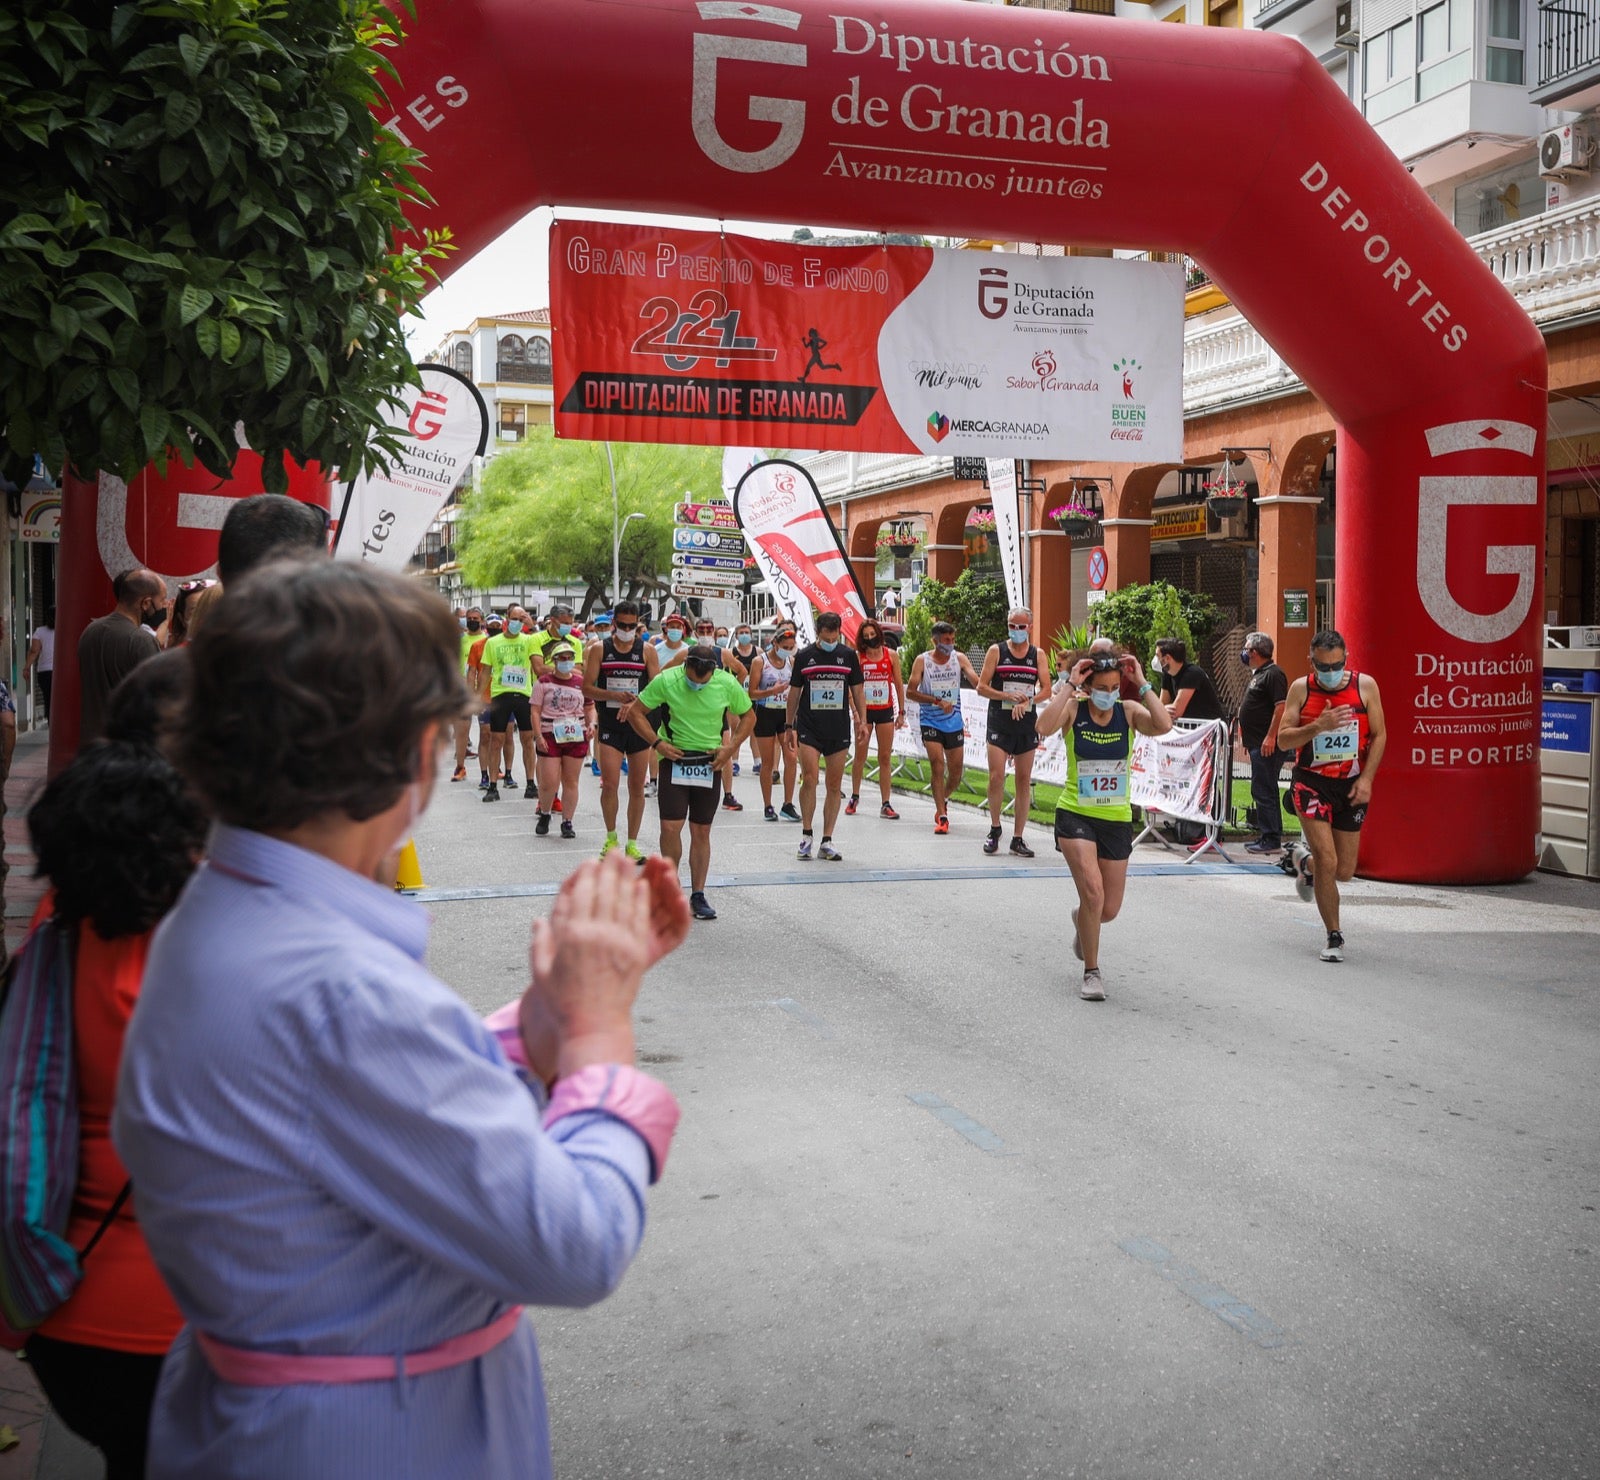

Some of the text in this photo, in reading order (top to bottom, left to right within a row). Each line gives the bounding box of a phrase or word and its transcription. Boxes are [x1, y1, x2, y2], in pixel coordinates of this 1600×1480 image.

[829, 15, 1112, 82] Diputación
[831, 75, 1110, 148] de Granada
[823, 150, 1103, 199] Avanzamos junt@s
[1300, 161, 1468, 352] DEPORTES
[763, 261, 794, 287] DE
[1014, 282, 1095, 301] Diputación
[1013, 301, 1095, 318] de Granada
[1013, 323, 1088, 336] Avanzamos junt@s
[908, 360, 989, 376] GRANADA
[915, 369, 947, 388] Mil
[1006, 376, 1099, 391] Sabor Granada
[585, 379, 847, 421] DIPUTACIÓN DE GRANADA
[1112, 409, 1146, 420] BUEN
[950, 419, 1050, 435] MERCAGRANADA
[1415, 653, 1533, 682] Diputación
[822, 691, 835, 701] 42
[941, 690, 952, 699] 24
[1414, 682, 1533, 709] de Granada
[565, 726, 576, 735] 26
[1413, 718, 1533, 736] Avanzamos junt@s
[1325, 735, 1351, 749] 242
[1411, 743, 1533, 766] DEPORTES
[680, 766, 708, 777] 1004
[1091, 777, 1118, 792] 125
